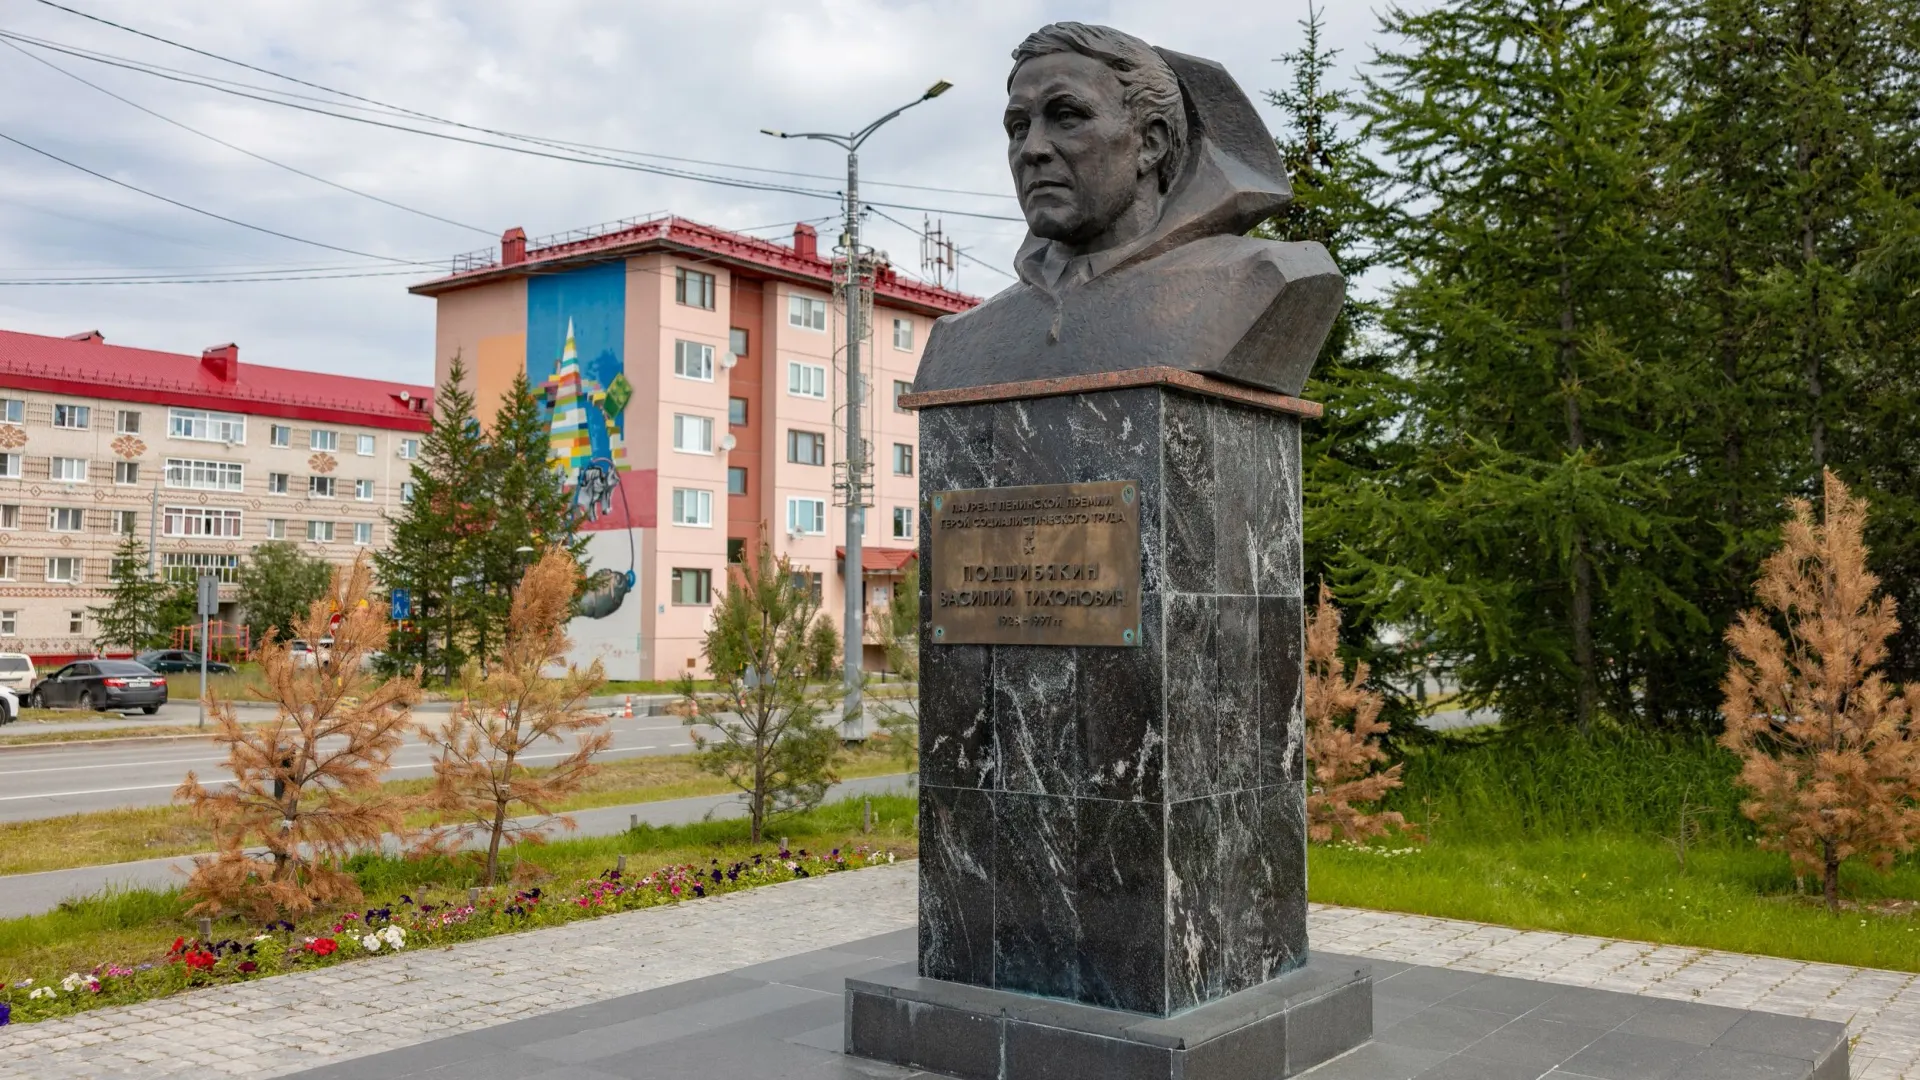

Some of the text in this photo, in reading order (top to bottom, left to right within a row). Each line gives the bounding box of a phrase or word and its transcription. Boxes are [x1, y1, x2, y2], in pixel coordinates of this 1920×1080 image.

[952, 495, 1114, 514] ЛАУРЕАТ ЛЕНИНСКОЙ ПРЕМИИ
[940, 511, 1126, 529] ГЕРОЙ СОЦИАЛИСТИЧЕСКОГО ТРУДА
[963, 564, 1099, 582] ПОДШИБЯКИН
[940, 587, 1128, 607] ВАСИЛИЙ ТИХОНОВИЧ
